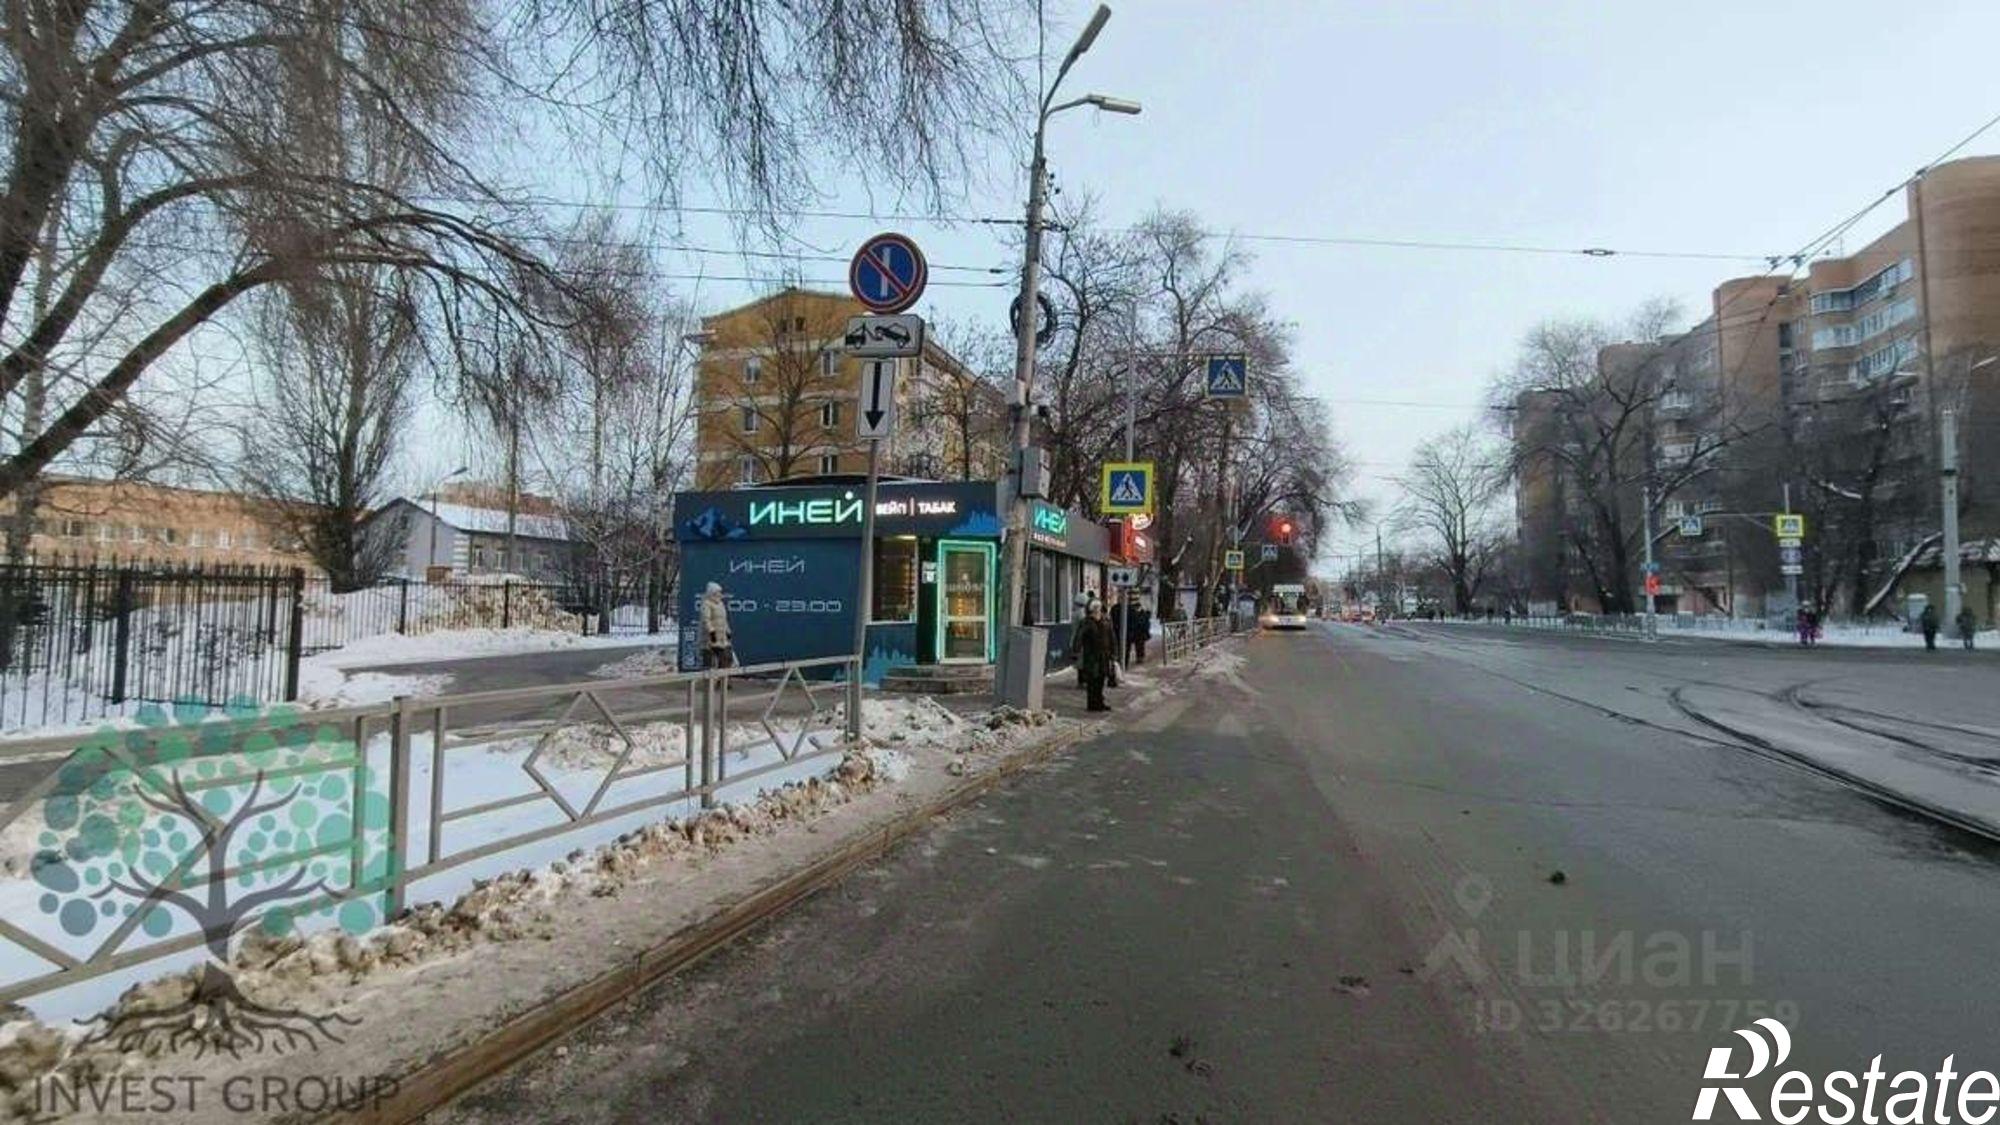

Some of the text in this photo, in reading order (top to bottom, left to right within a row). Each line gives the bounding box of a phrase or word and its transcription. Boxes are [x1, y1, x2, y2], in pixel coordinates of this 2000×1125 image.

[749, 491, 863, 525] ИНЕЙ
[917, 501, 956, 514] ТАБАК
[730, 555, 805, 573] ИНЕЙ
